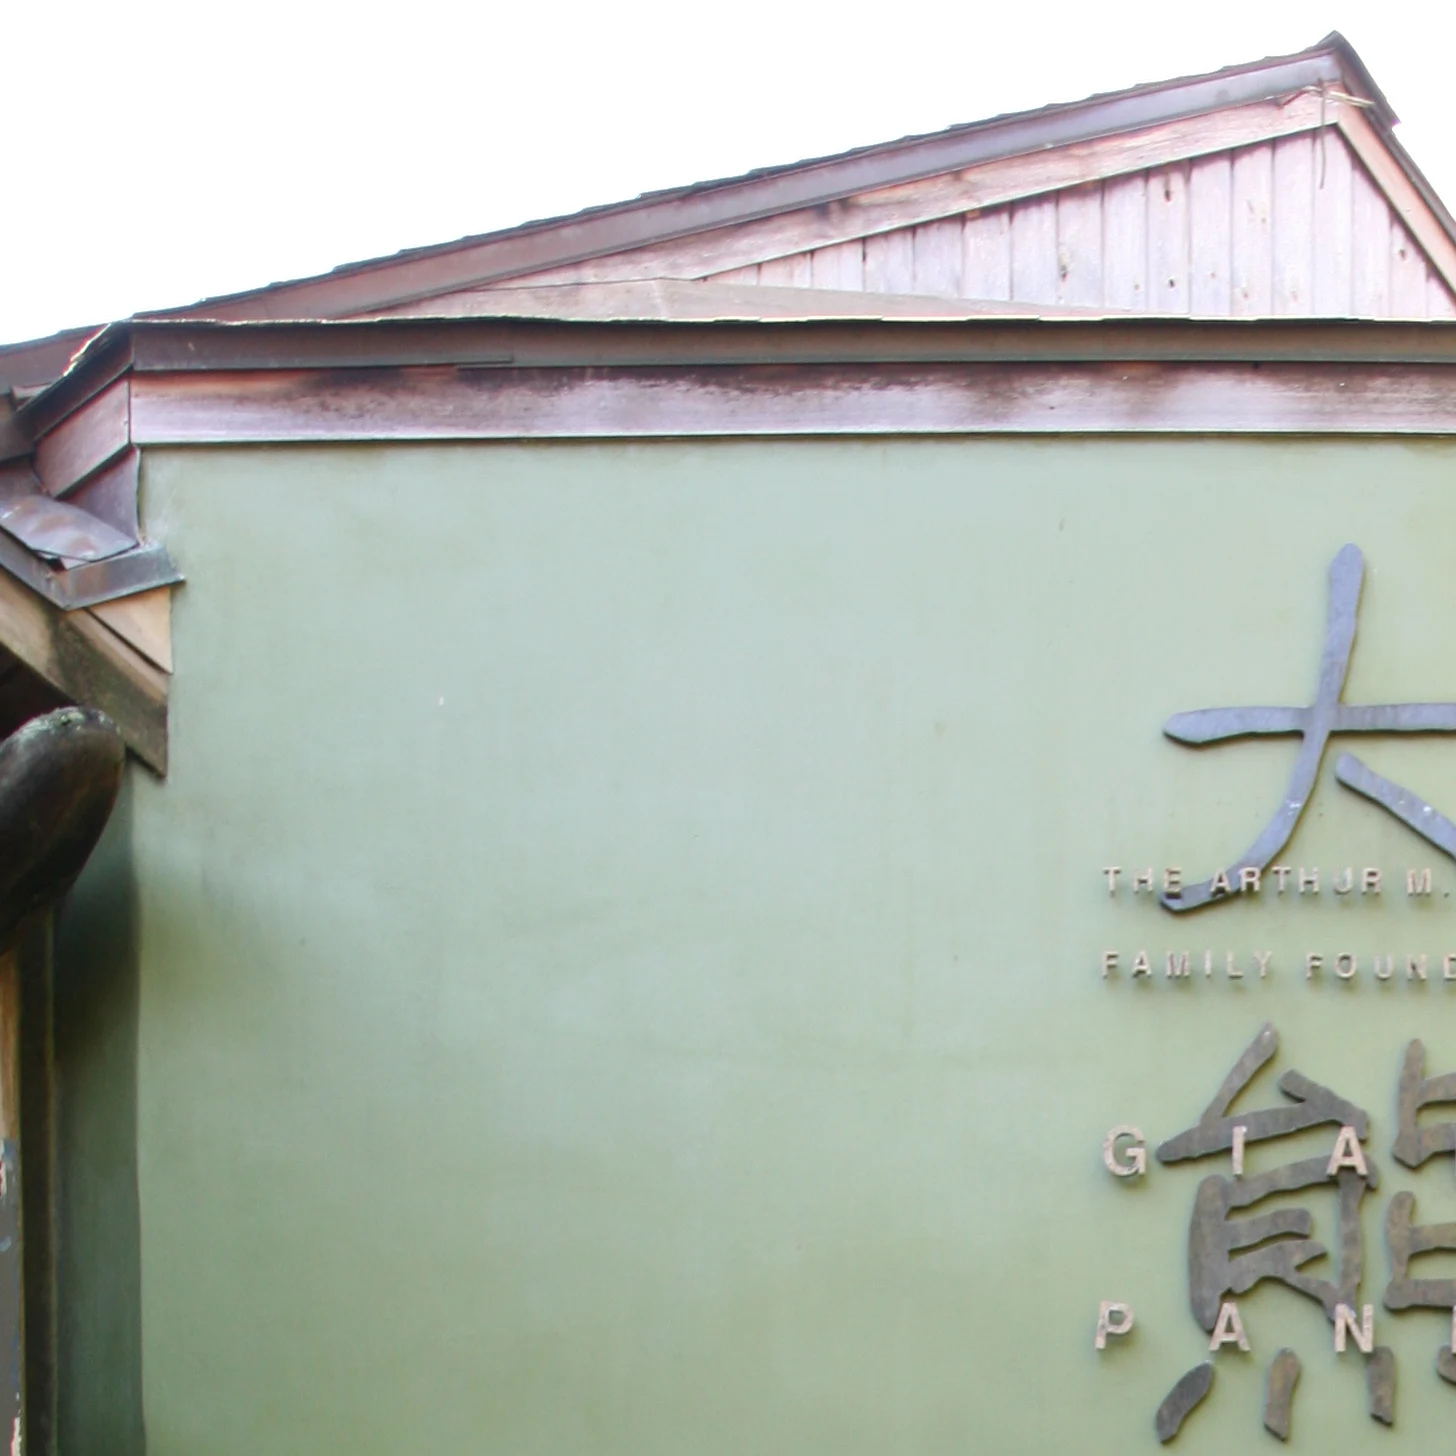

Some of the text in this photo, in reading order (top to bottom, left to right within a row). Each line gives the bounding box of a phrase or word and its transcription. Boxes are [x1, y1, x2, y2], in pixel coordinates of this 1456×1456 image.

[1103, 866, 1183, 893] THE
[1210, 865, 1383, 896] ARTHUR
[1406, 867, 1451, 897] M.
[1101, 949, 1274, 980] FAMILY
